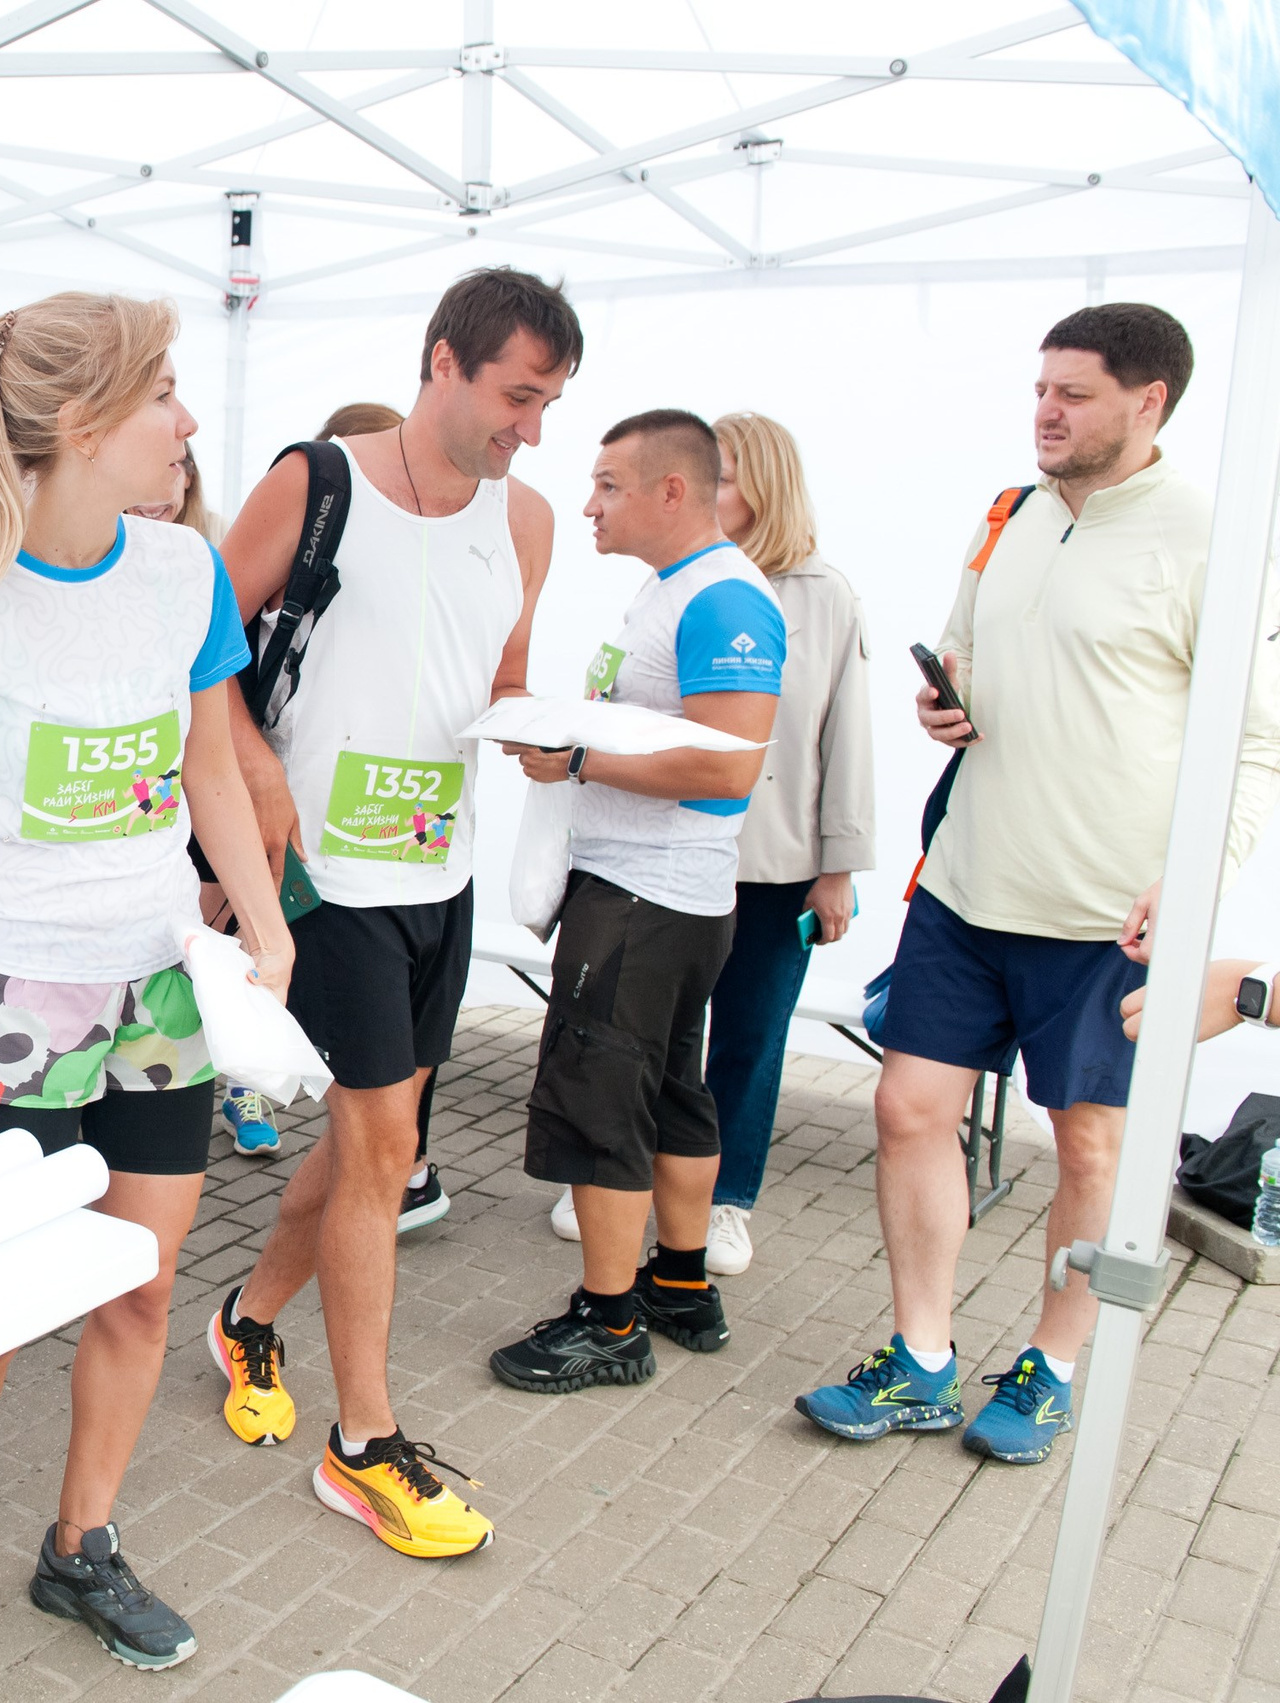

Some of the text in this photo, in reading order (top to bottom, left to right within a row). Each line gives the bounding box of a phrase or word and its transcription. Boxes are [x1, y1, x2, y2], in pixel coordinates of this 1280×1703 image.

[712, 657, 773, 666] ЛИНИЯ ЖИЗНИ
[62, 727, 158, 773] 1355
[56, 779, 94, 795] ЗАБЕГ
[364, 763, 442, 802] 1352
[43, 788, 115, 807] РАДИ ЖИЗНИ
[68, 804, 83, 824] 5
[353, 803, 384, 816] ЗАБЕГ
[341, 814, 399, 827] РАДИ ЖИЗНИ
[359, 825, 373, 842] 5
